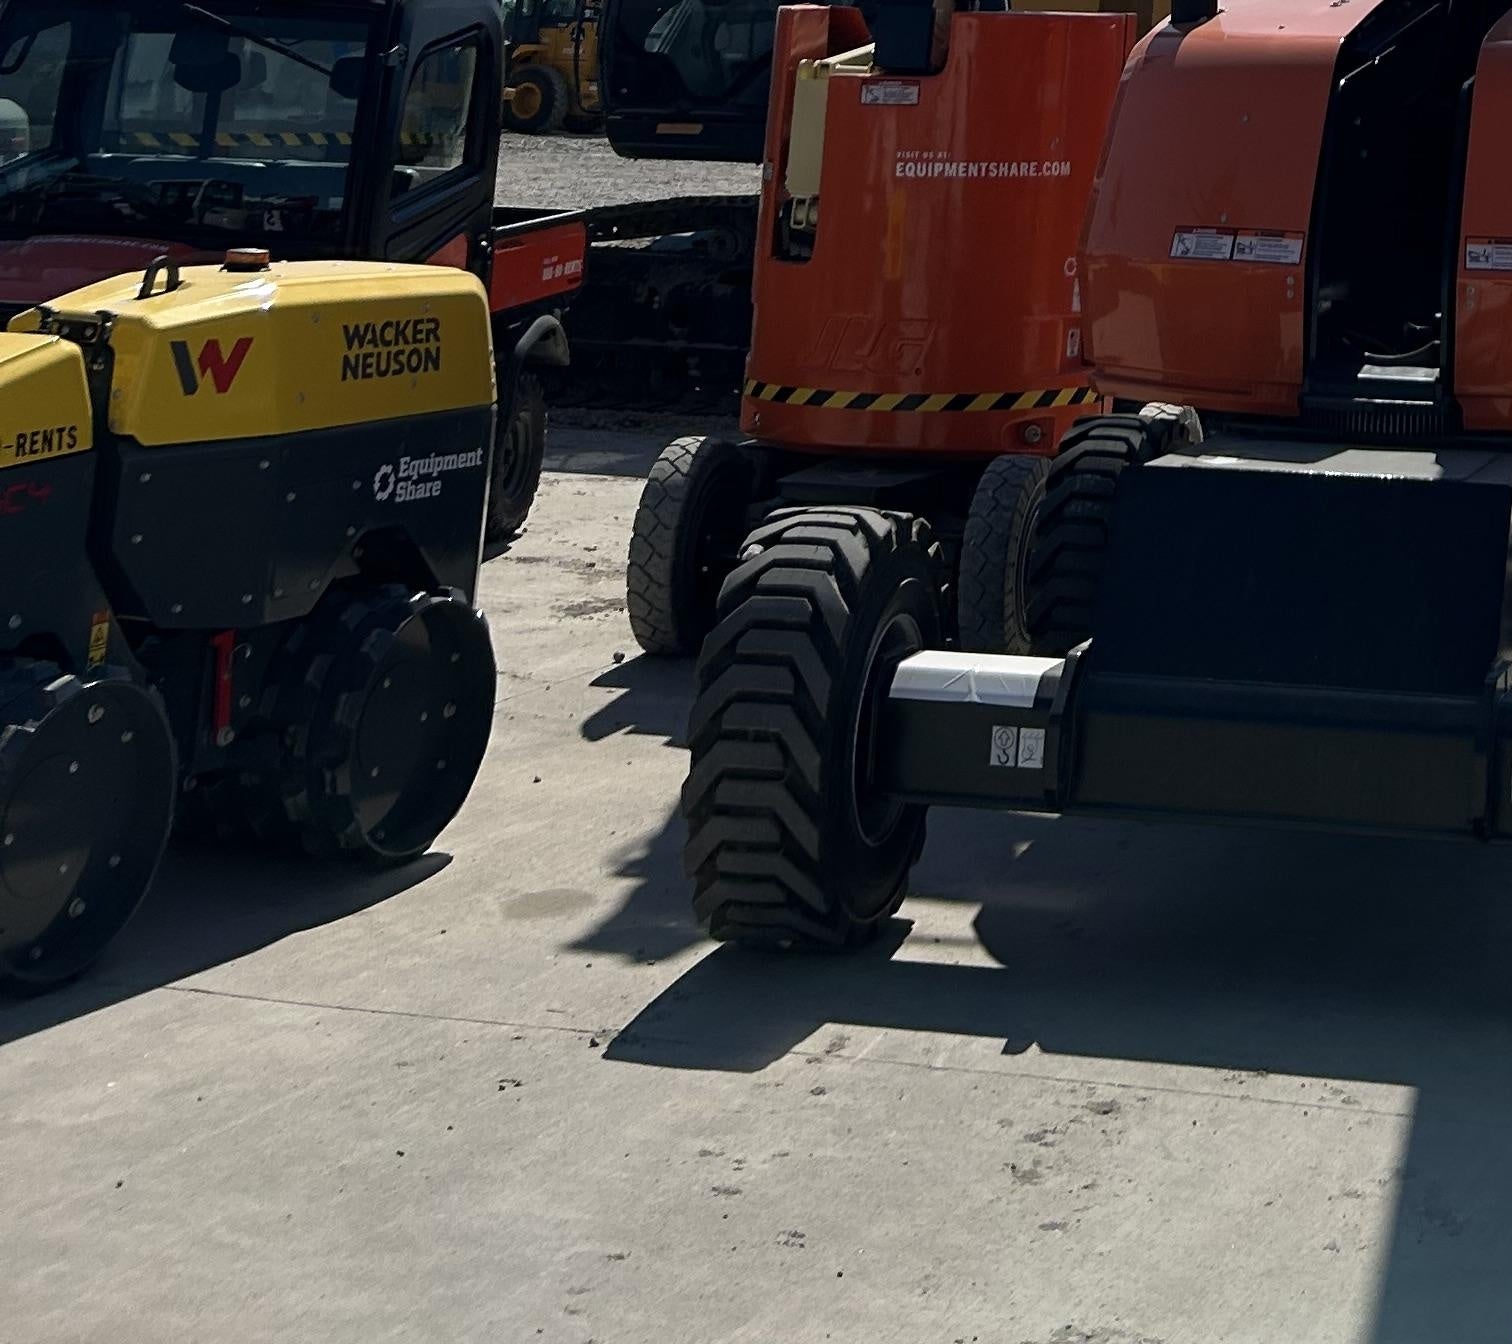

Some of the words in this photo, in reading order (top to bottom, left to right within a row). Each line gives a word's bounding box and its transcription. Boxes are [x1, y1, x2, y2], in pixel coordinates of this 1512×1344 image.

[895, 161, 1071, 178] EQUIPMENTSHARE.COM
[341, 317, 441, 352] WACKER
[340, 345, 441, 382] NEUSON
[0, 424, 78, 458] -RENTS
[398, 447, 484, 481] Equipment
[395, 479, 442, 503] Share
